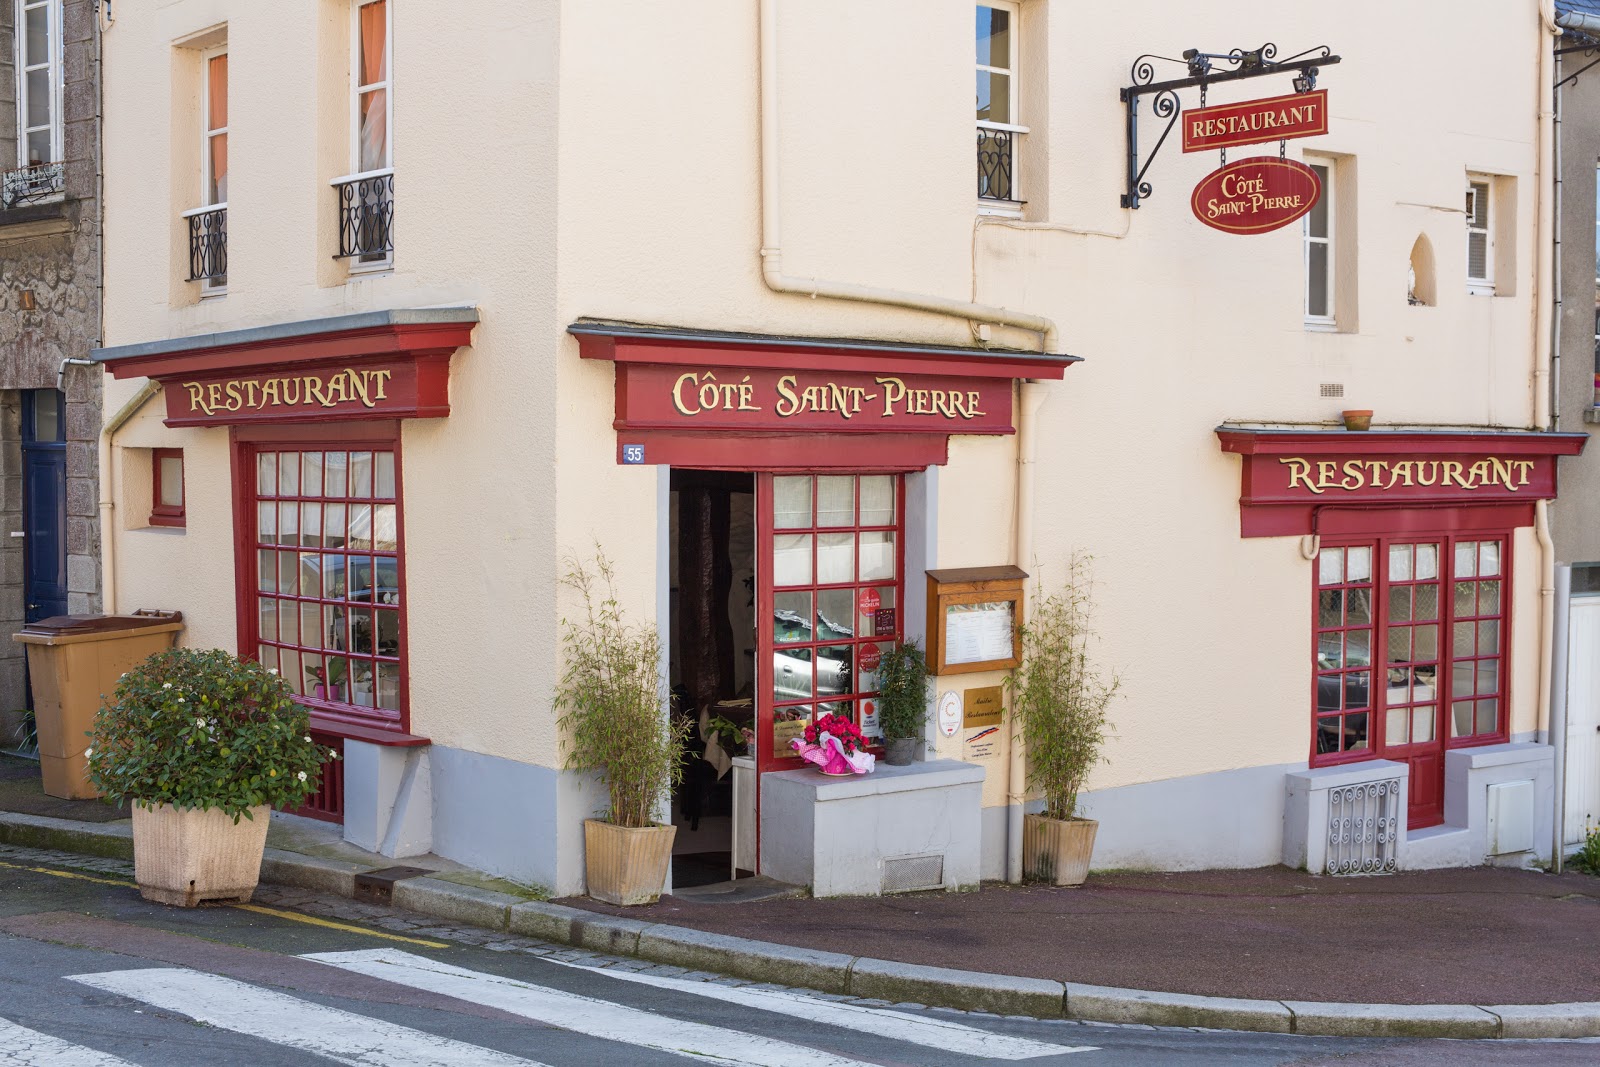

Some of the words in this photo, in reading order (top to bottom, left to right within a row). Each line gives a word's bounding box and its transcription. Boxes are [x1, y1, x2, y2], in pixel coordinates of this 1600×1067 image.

[1191, 104, 1317, 138] RESTAURANT
[1221, 173, 1268, 198] CÔTÉ
[1207, 194, 1304, 218] SAINT-PIERRE
[183, 368, 392, 416] RESTAURANT
[672, 371, 762, 416] CÔTÉ
[775, 375, 987, 419] SAINT-PIERRE
[627, 447, 642, 462] 55
[1279, 457, 1535, 494] RESTAURANT
